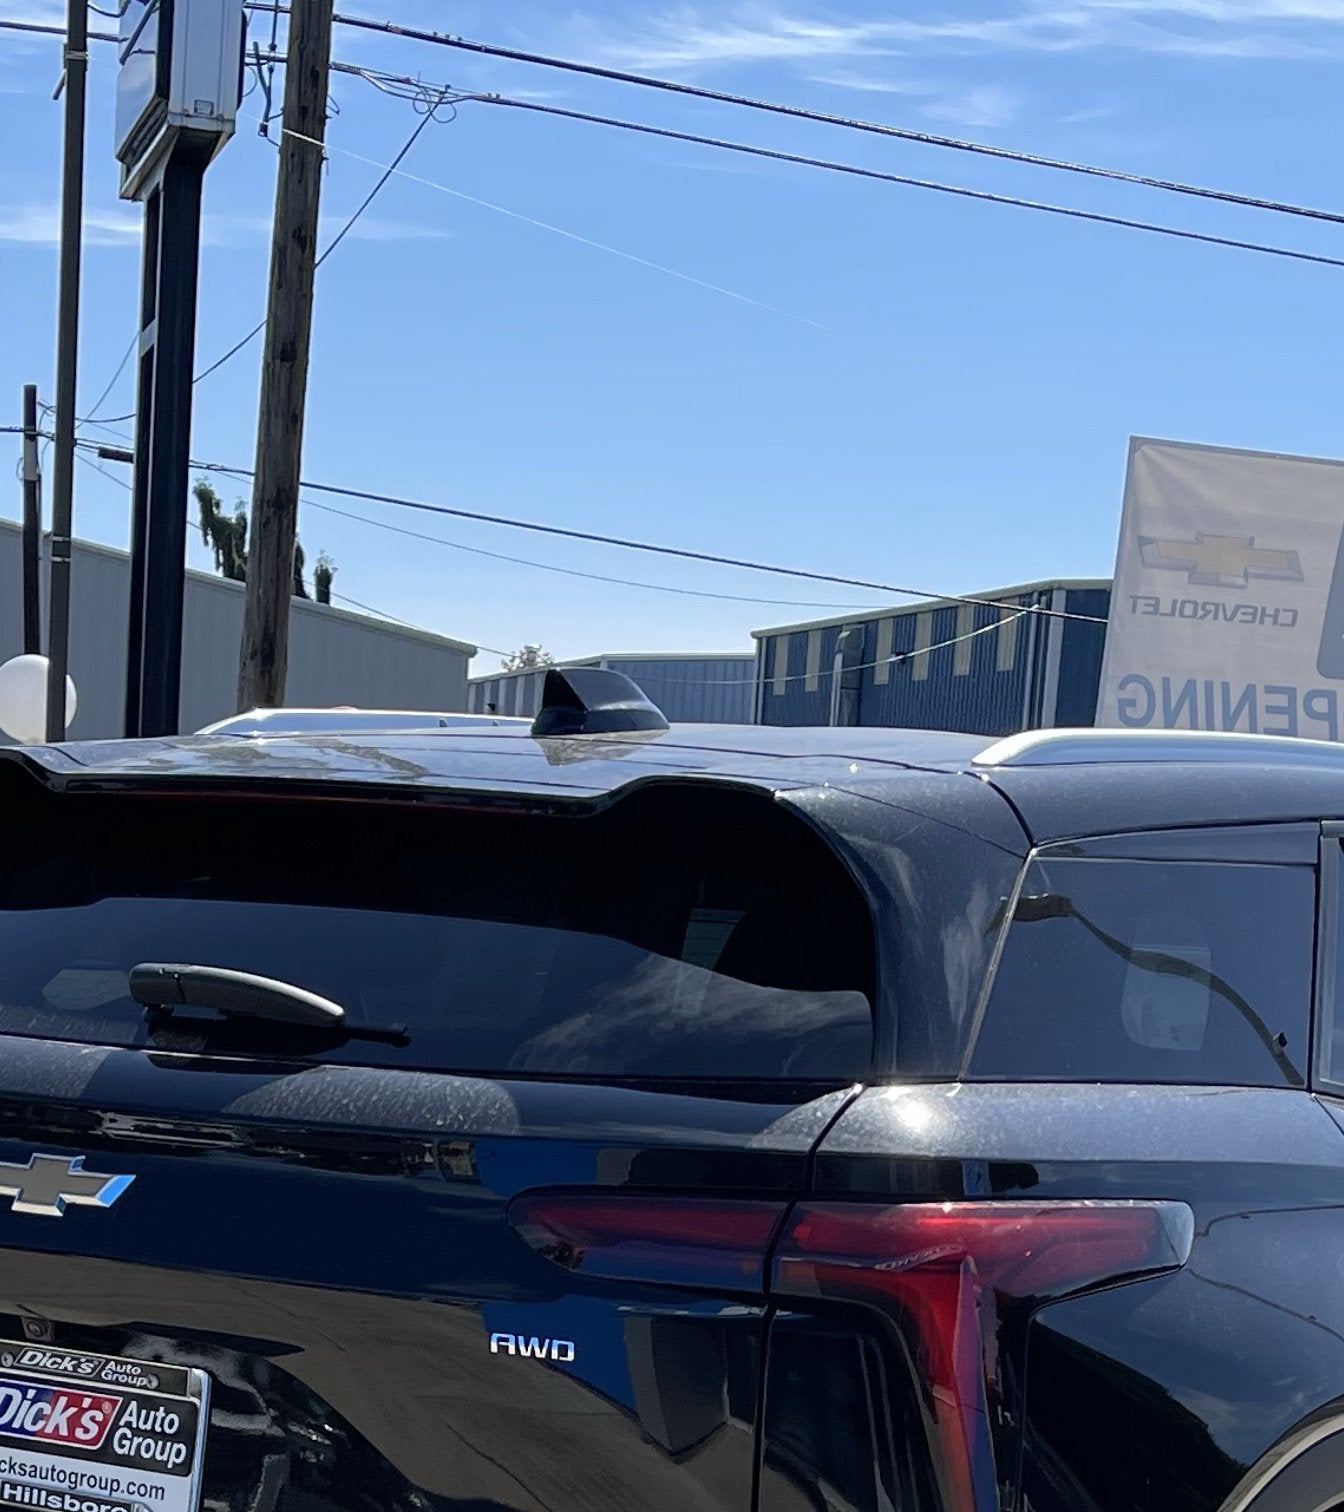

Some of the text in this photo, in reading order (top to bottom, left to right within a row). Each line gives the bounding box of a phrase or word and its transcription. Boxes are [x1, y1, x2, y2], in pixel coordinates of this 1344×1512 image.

[489, 1332, 575, 1362] AWD
[19, 1350, 96, 1375] Dick's
[105, 1361, 142, 1376] Auto
[100, 1369, 149, 1388] Group
[119, 1400, 180, 1435] Auto
[113, 1427, 188, 1469] Group
